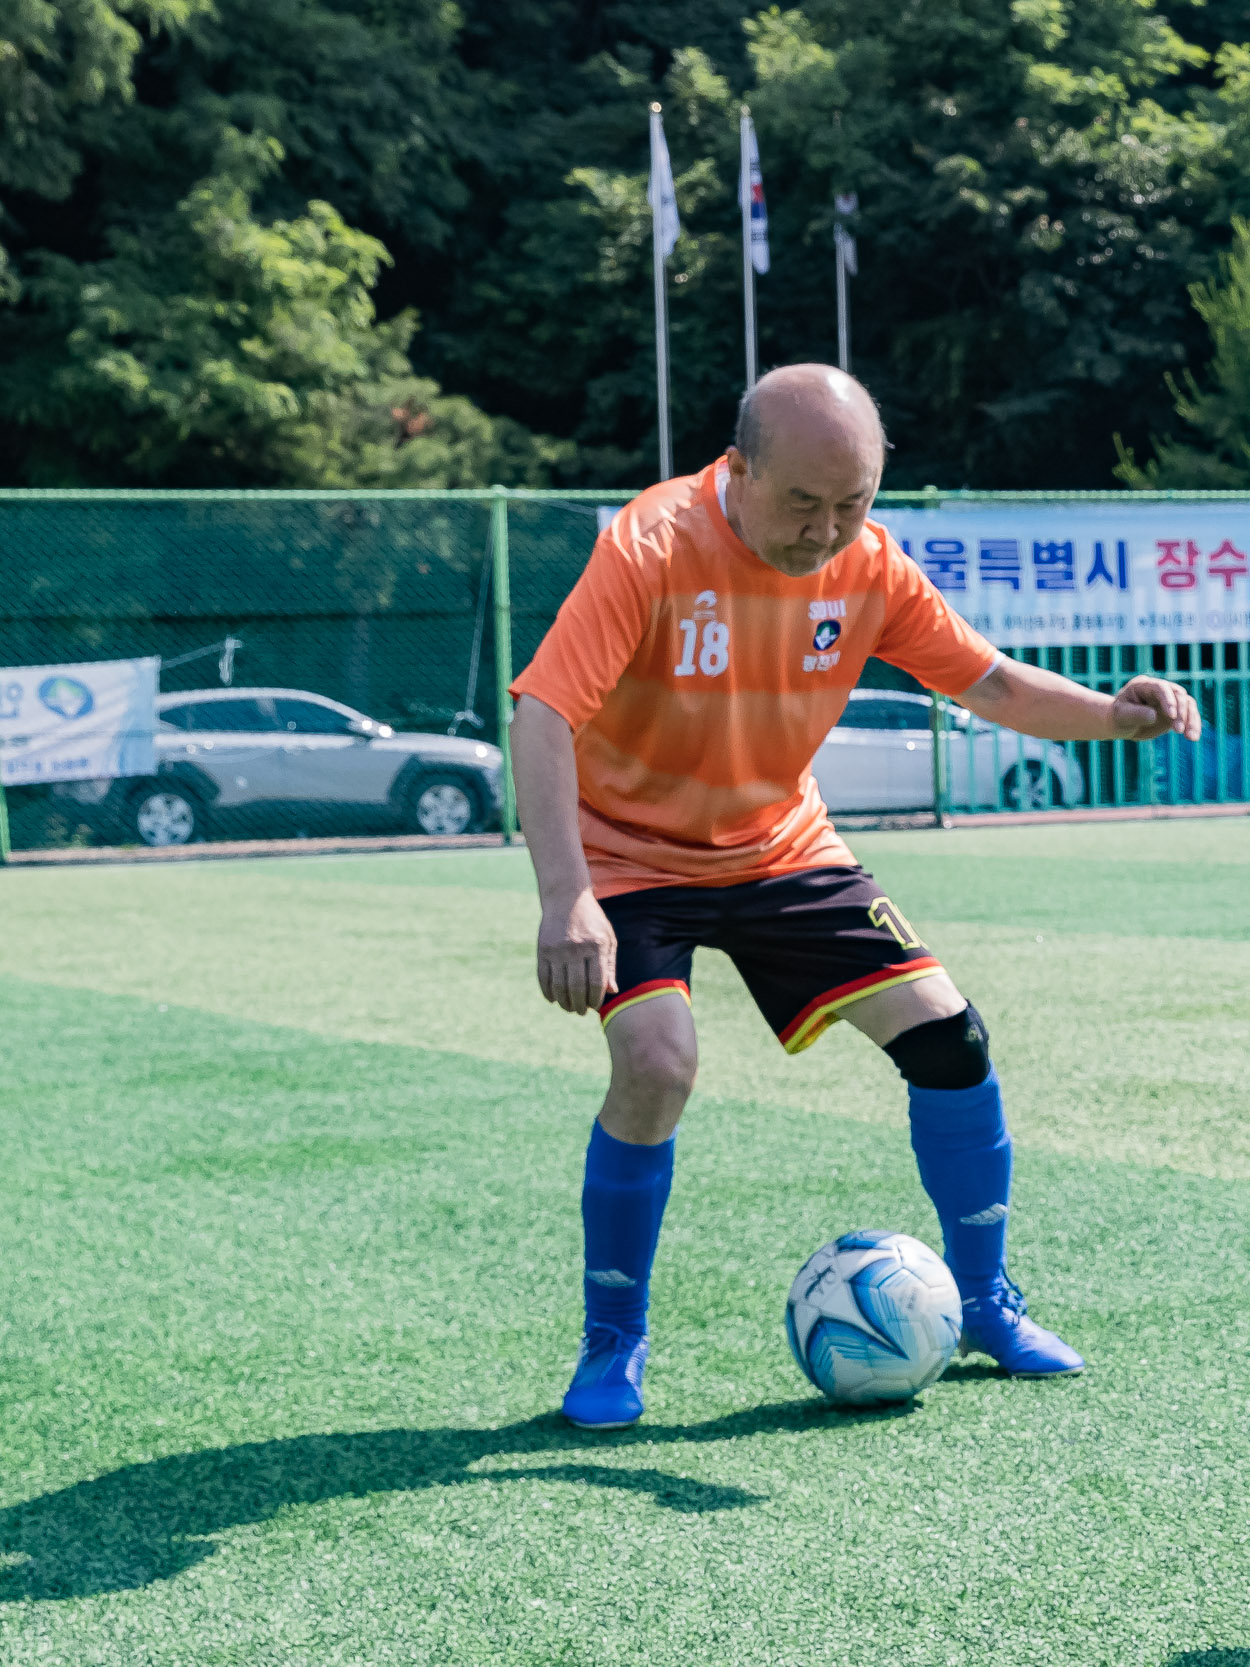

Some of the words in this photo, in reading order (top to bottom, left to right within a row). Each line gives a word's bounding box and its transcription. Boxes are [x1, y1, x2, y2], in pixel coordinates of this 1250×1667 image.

[902, 538, 1129, 592] 울특별시
[674, 619, 730, 677] 18
[867, 896, 929, 951] 1
